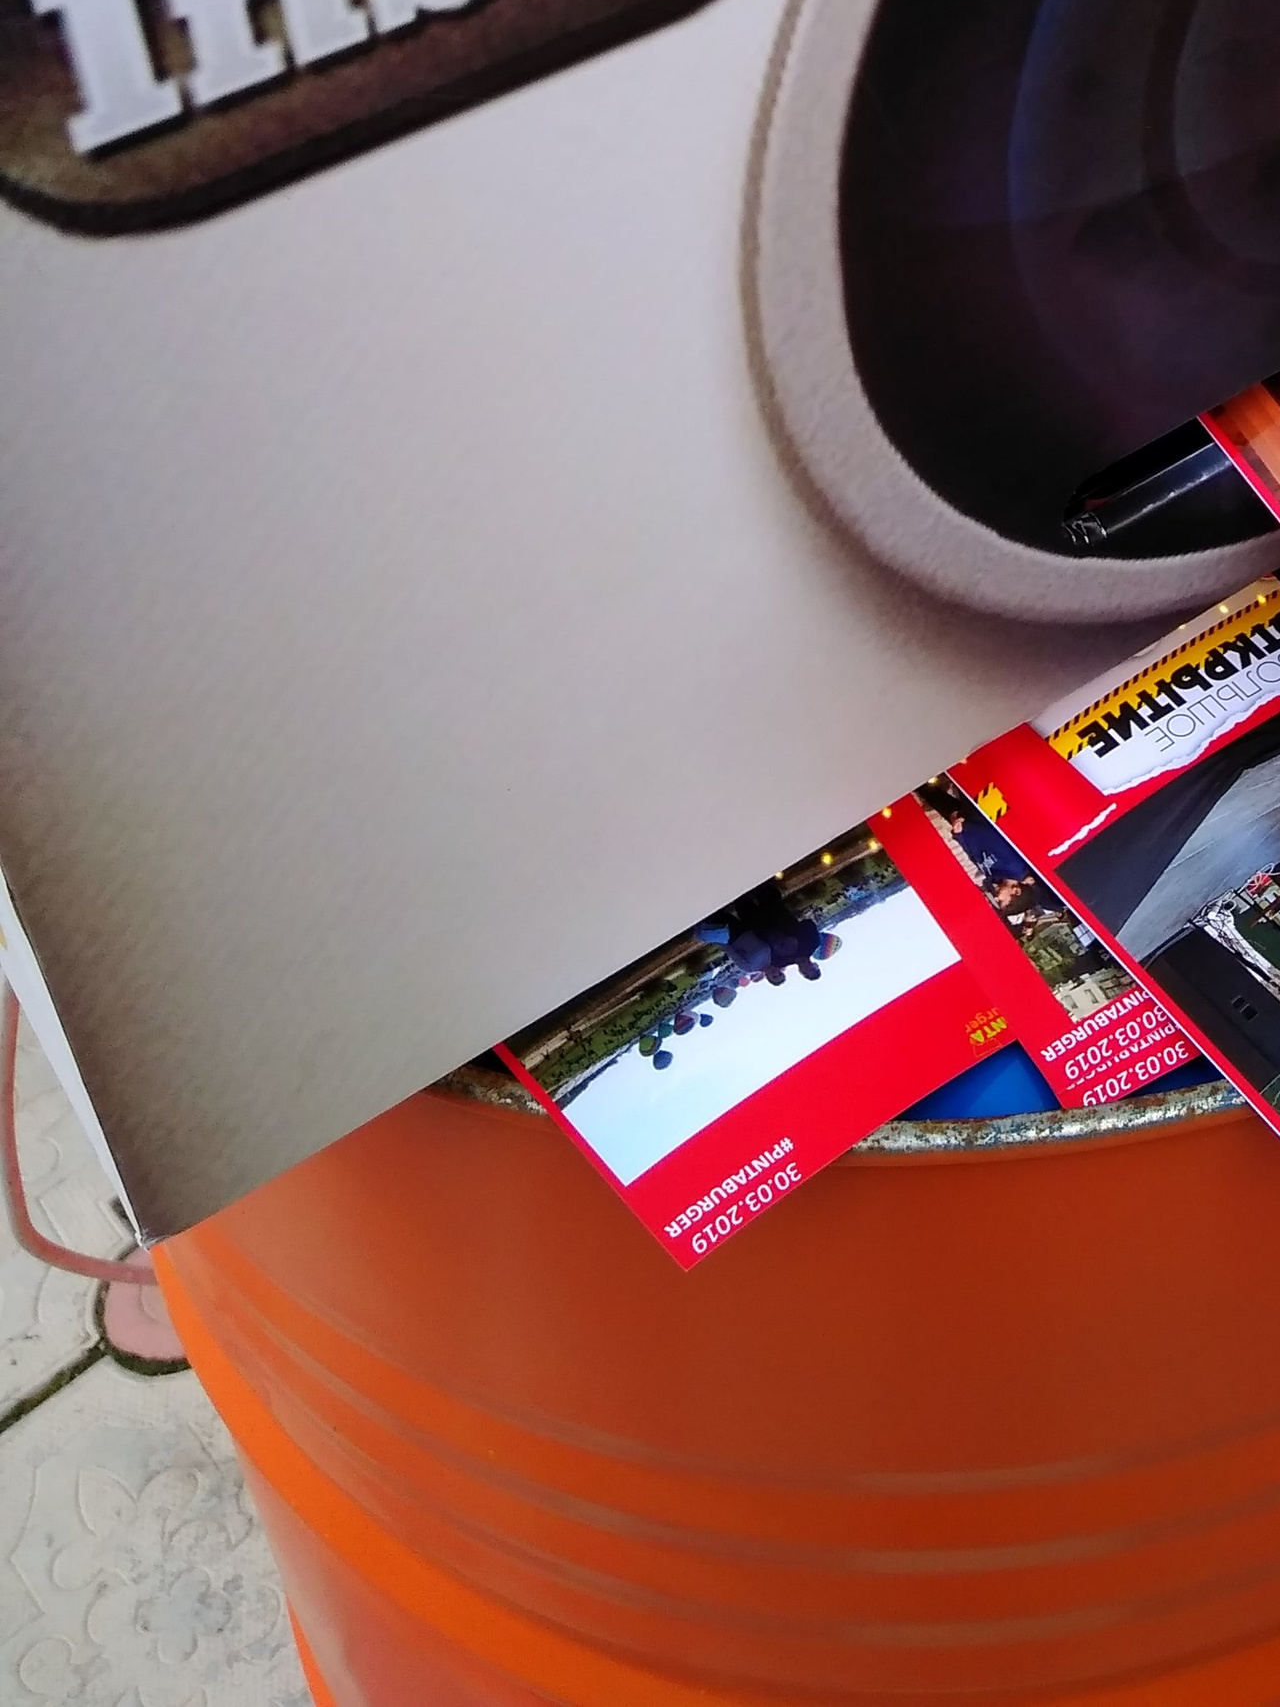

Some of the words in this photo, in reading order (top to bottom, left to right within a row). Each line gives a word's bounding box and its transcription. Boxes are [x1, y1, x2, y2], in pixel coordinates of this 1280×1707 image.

[969, 1016, 1008, 1043] NTA
[1064, 1005, 1168, 1080] 30.03.2019
[664, 1137, 794, 1240] #PINTABURGER
[691, 1162, 802, 1254] 30.03.2019
